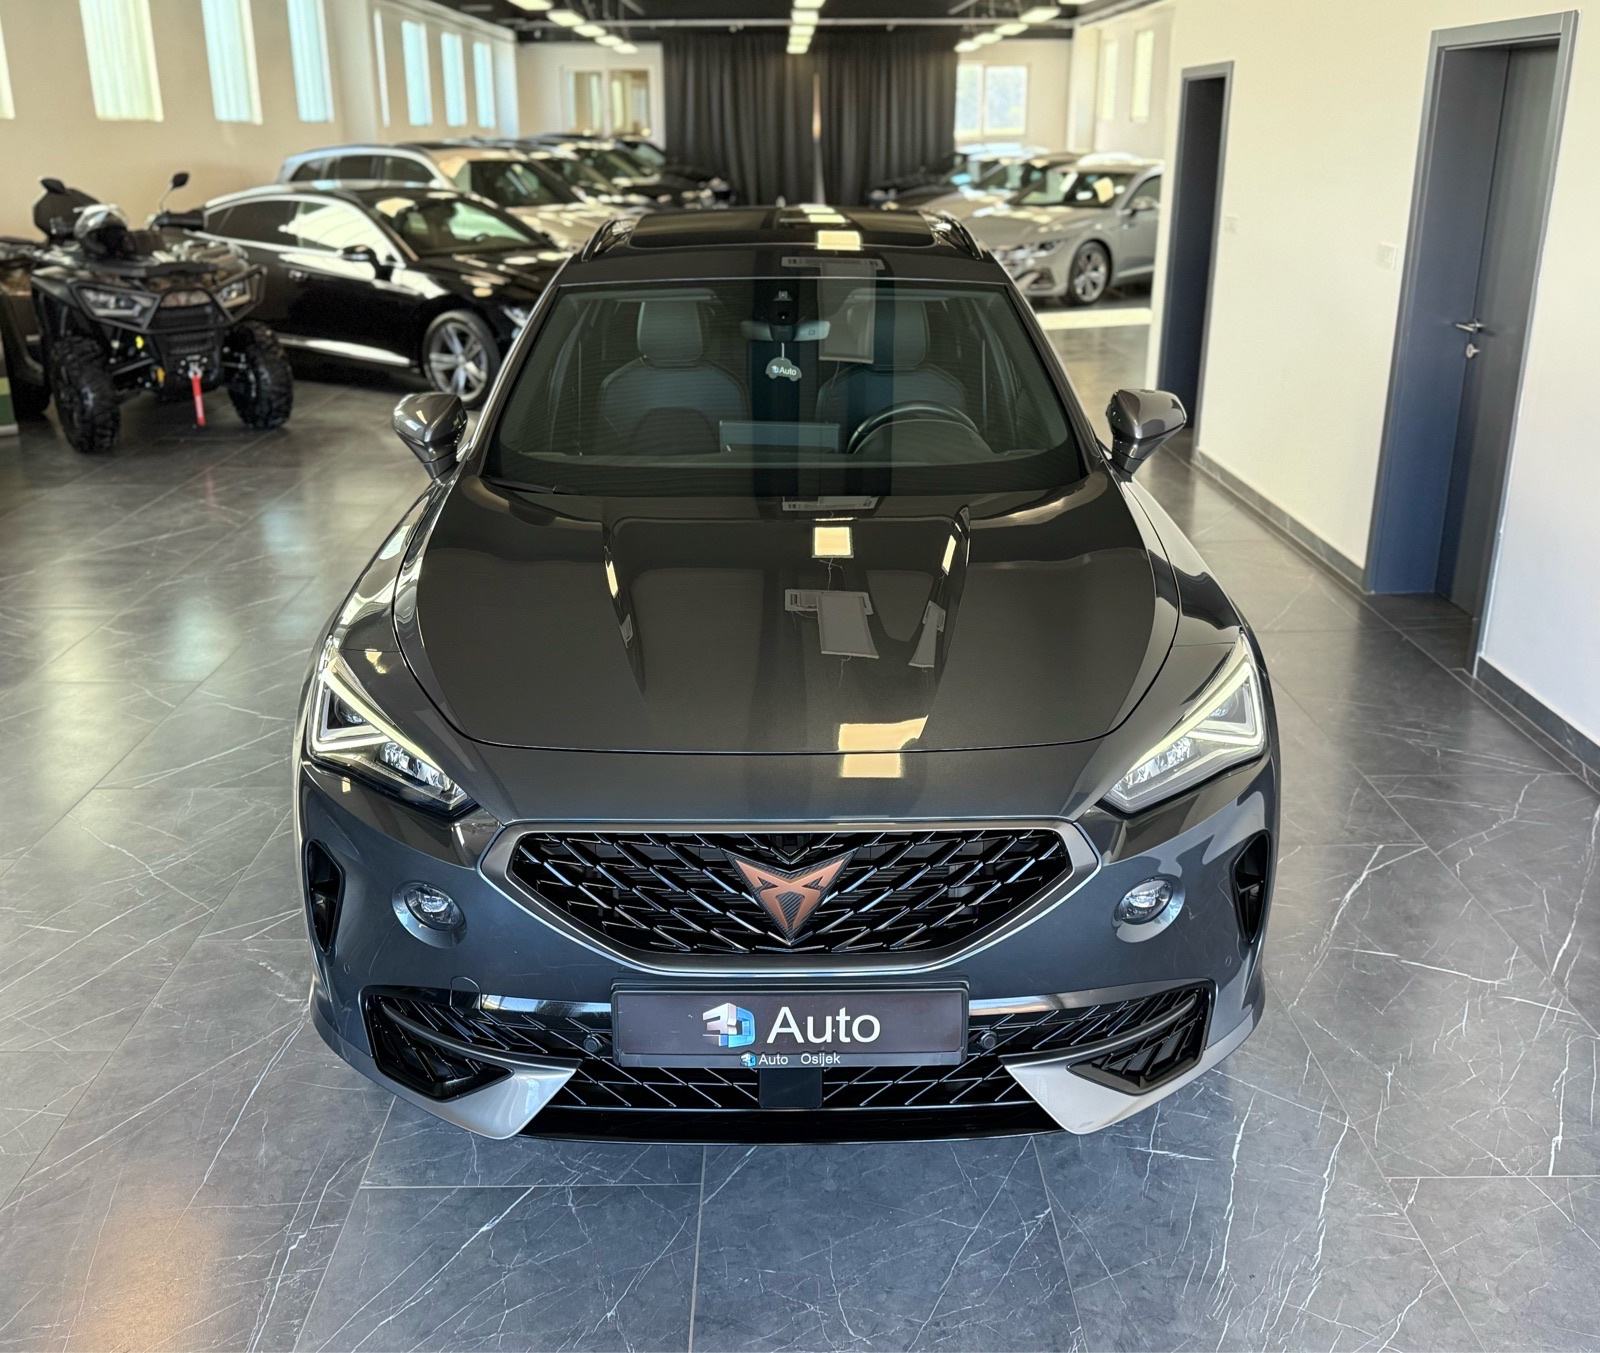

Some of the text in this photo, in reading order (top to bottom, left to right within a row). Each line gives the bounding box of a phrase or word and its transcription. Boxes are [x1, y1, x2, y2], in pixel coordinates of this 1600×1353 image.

[779, 366, 797, 376] Auto
[766, 1006, 881, 1044] Auto
[758, 1053, 789, 1065] Auto
[800, 1052, 841, 1067] Osijek
